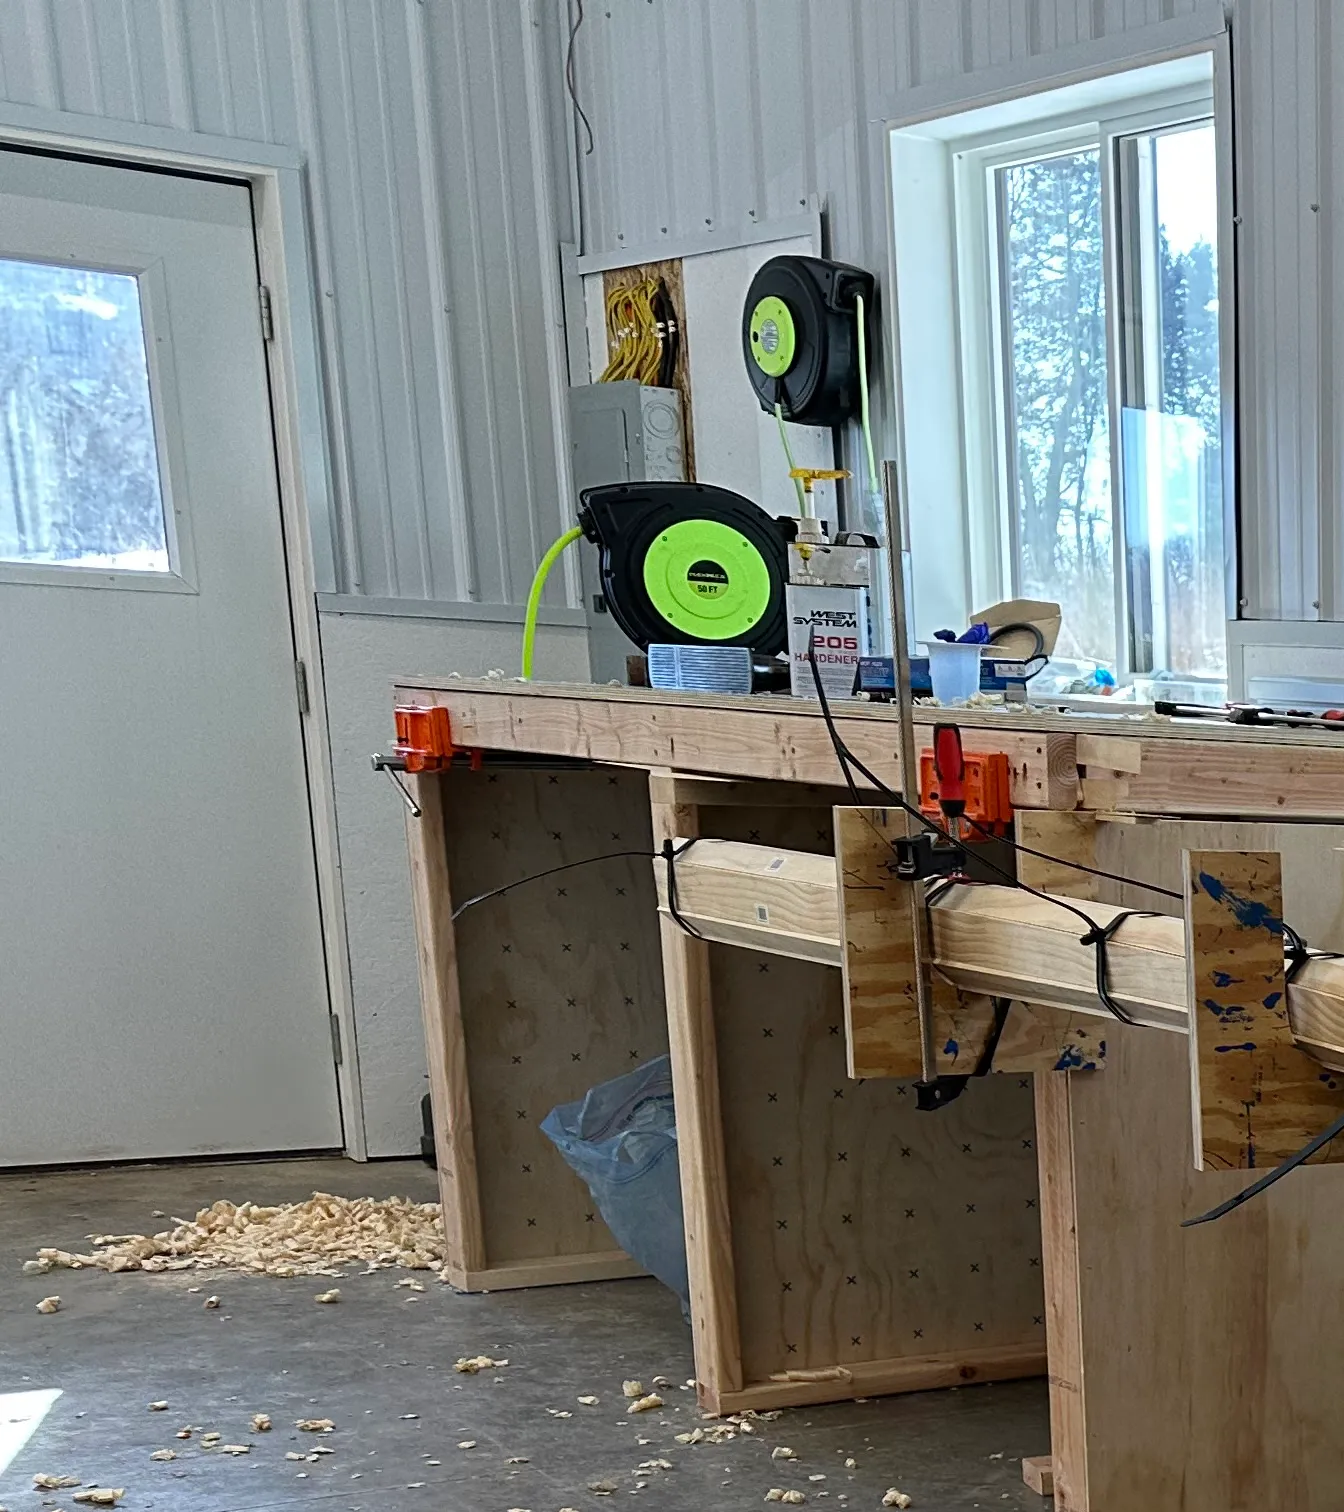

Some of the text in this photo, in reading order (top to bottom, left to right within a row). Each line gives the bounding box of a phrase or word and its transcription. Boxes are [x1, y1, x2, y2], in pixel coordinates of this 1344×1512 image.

[697, 584, 718, 593] 50 FT
[811, 610, 857, 620] WEST
[793, 616, 857, 628] SYSTEM
[813, 635, 858, 650] 205
